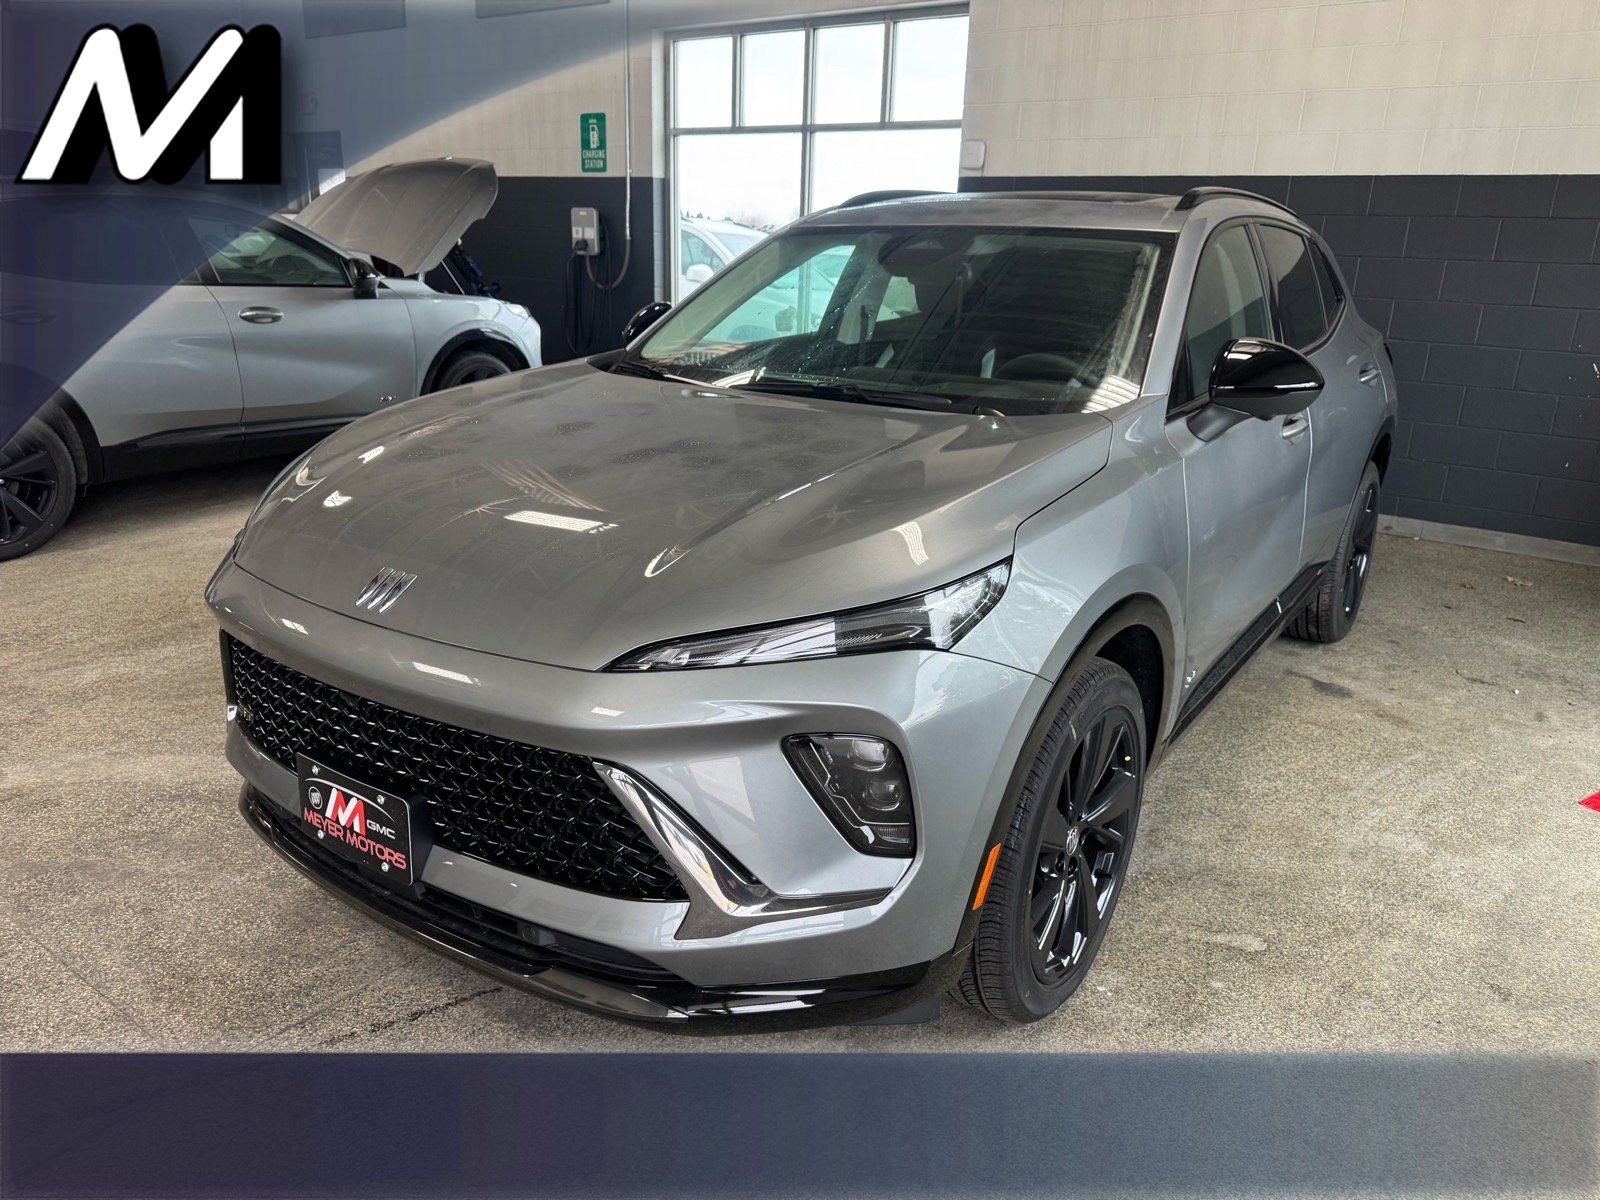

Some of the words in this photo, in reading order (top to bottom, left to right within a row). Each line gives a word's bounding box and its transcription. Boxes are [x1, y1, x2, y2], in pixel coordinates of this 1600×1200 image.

[582, 150, 605, 158] CHARGING
[584, 160, 604, 168] STATION
[325, 787, 366, 837] M
[303, 806, 345, 841] MEYER
[345, 829, 407, 870] MOTORS
[366, 819, 396, 840] GMC
